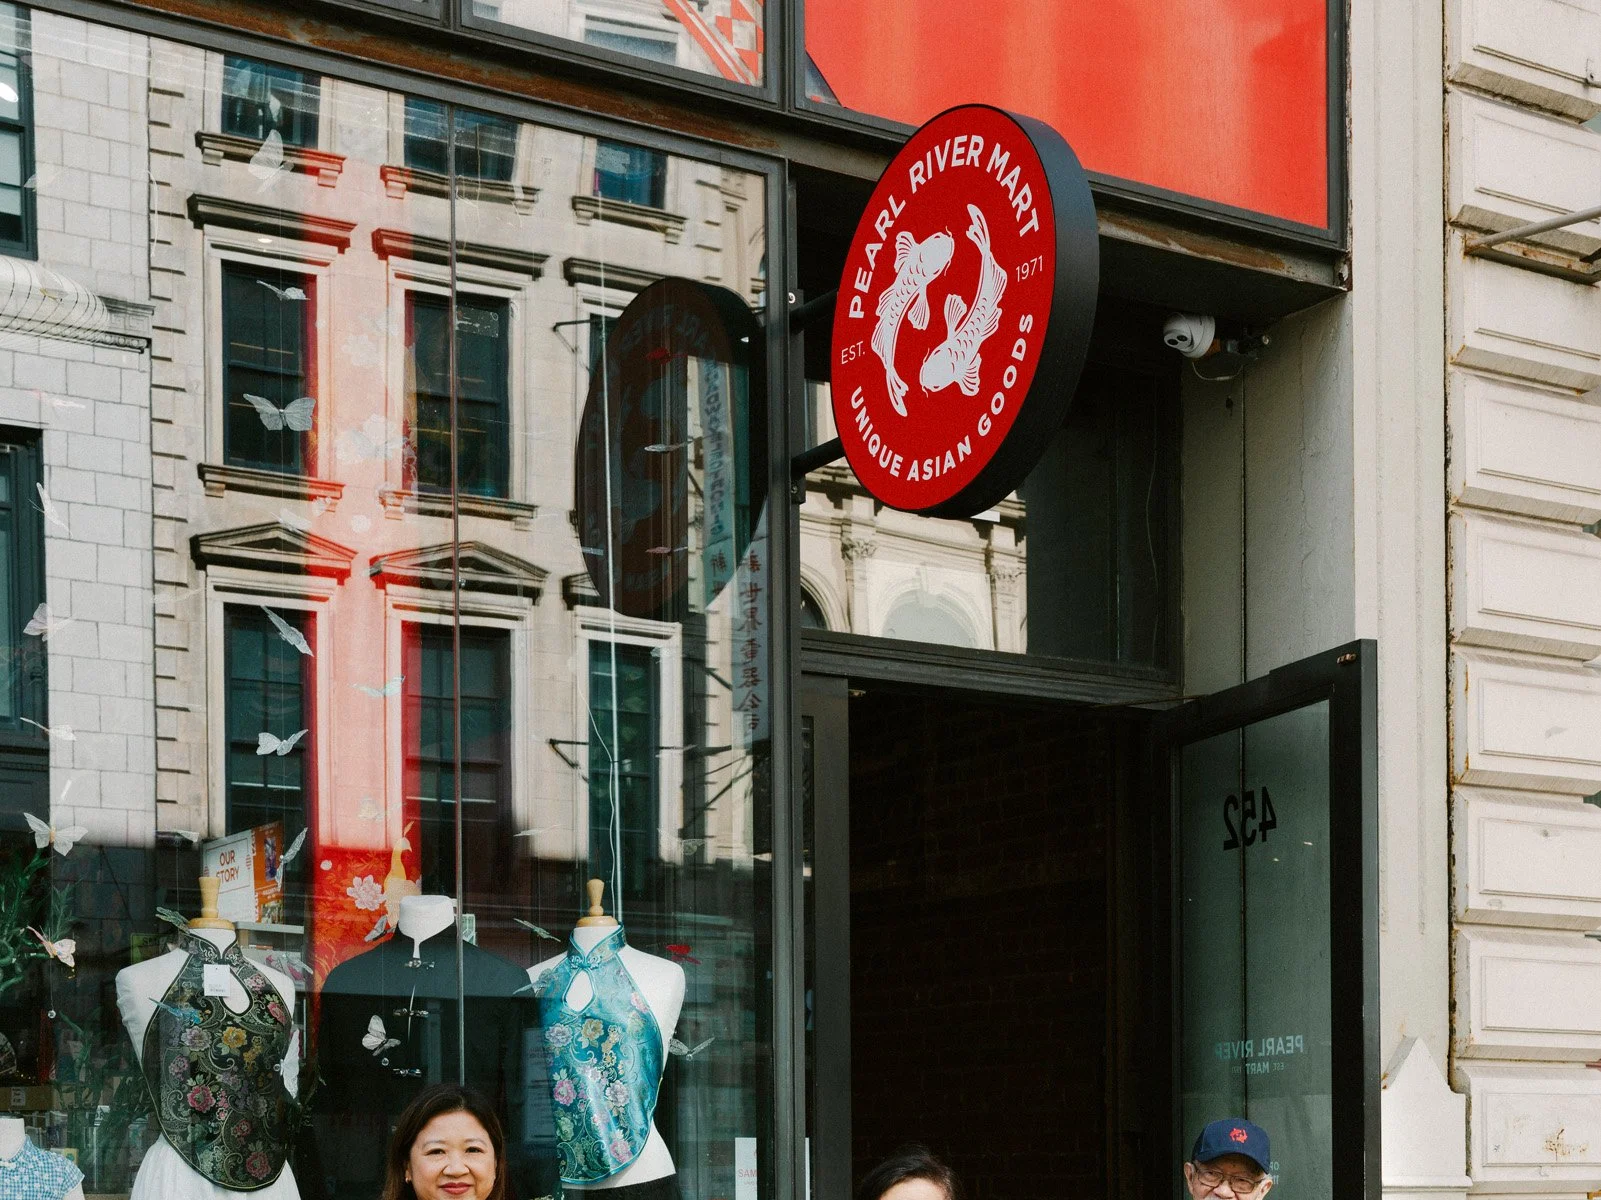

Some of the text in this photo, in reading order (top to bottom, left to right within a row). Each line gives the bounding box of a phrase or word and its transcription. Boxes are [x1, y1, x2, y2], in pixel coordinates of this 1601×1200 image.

[848, 134, 1039, 319] PEARL RIVER MART
[1015, 255, 1044, 282] 1971
[840, 341, 866, 365] EST.
[850, 313, 1034, 482] UNIQUE ASIAN GOODS
[219, 849, 236, 867] OUR
